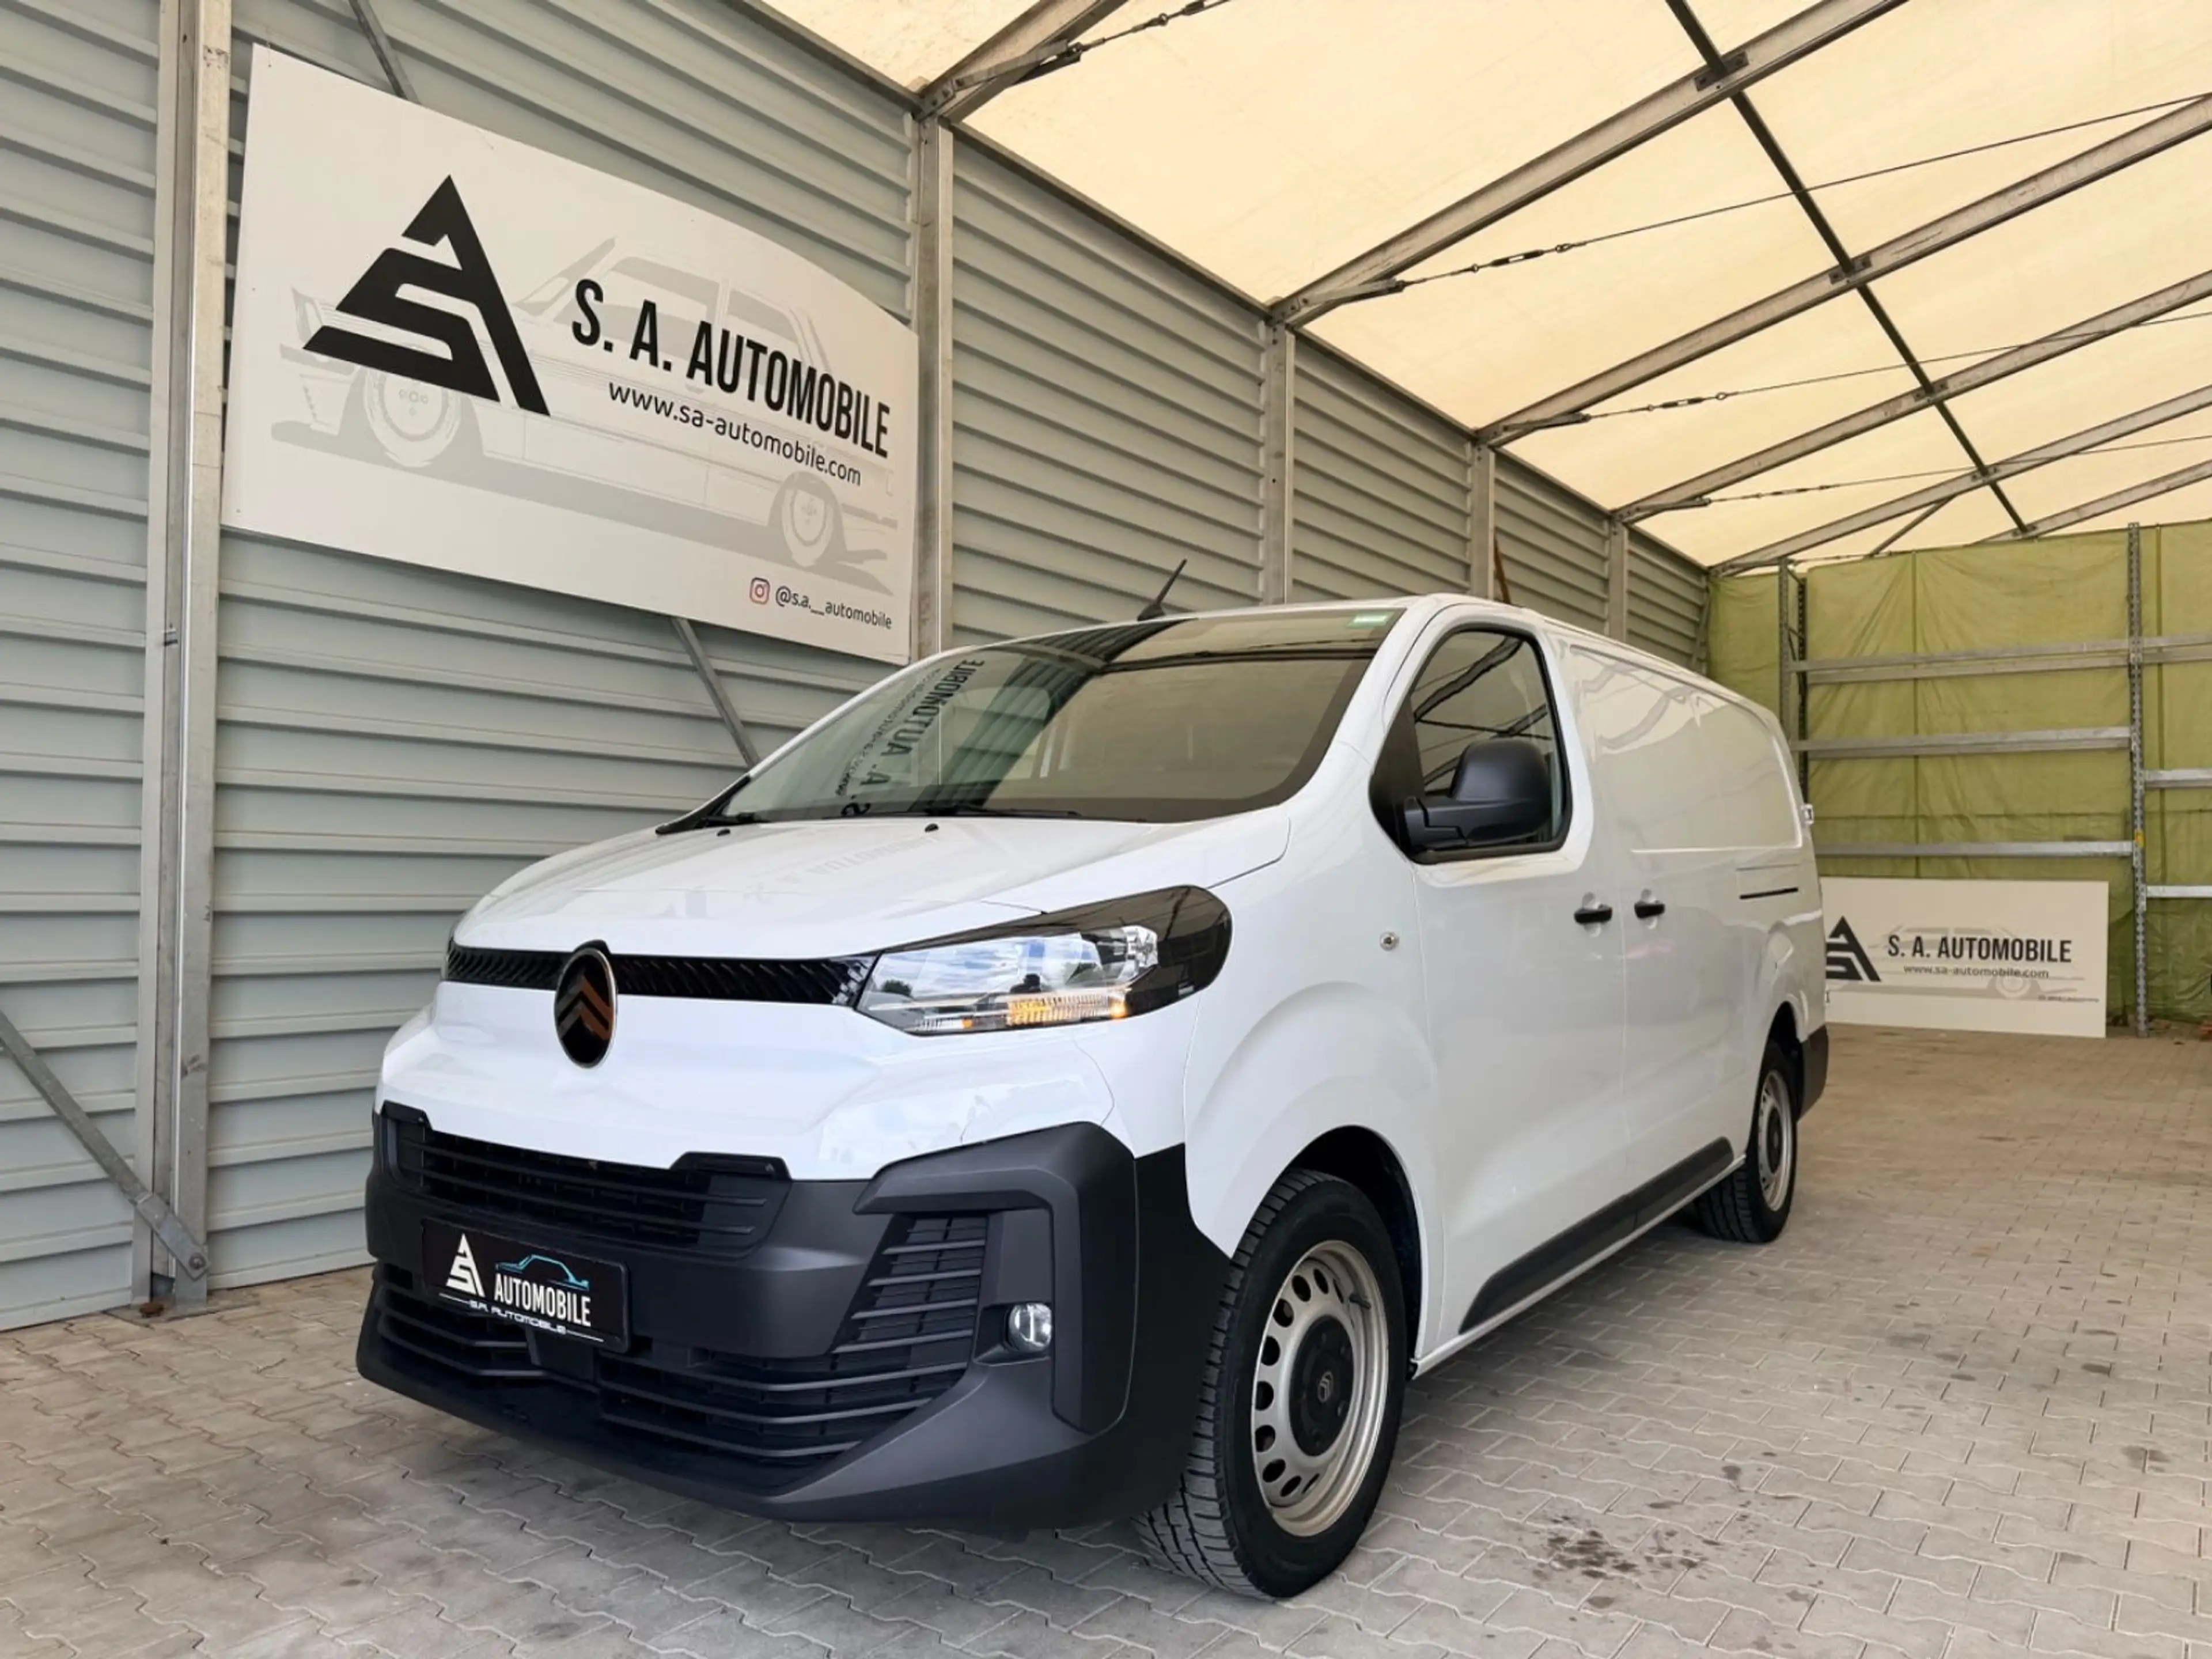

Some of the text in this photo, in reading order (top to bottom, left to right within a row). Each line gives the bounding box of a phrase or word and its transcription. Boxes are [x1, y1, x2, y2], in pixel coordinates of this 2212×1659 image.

[571, 279, 891, 459] S. A. AUTOMOBILE
[608, 382, 862, 487] www.sa-automobile.com
[1887, 934, 2073, 963] S. A. AUTOMOBILE
[1903, 965, 2050, 979] www.sa-automobile.com
[494, 1273, 592, 1327] AUTOMOBILE
